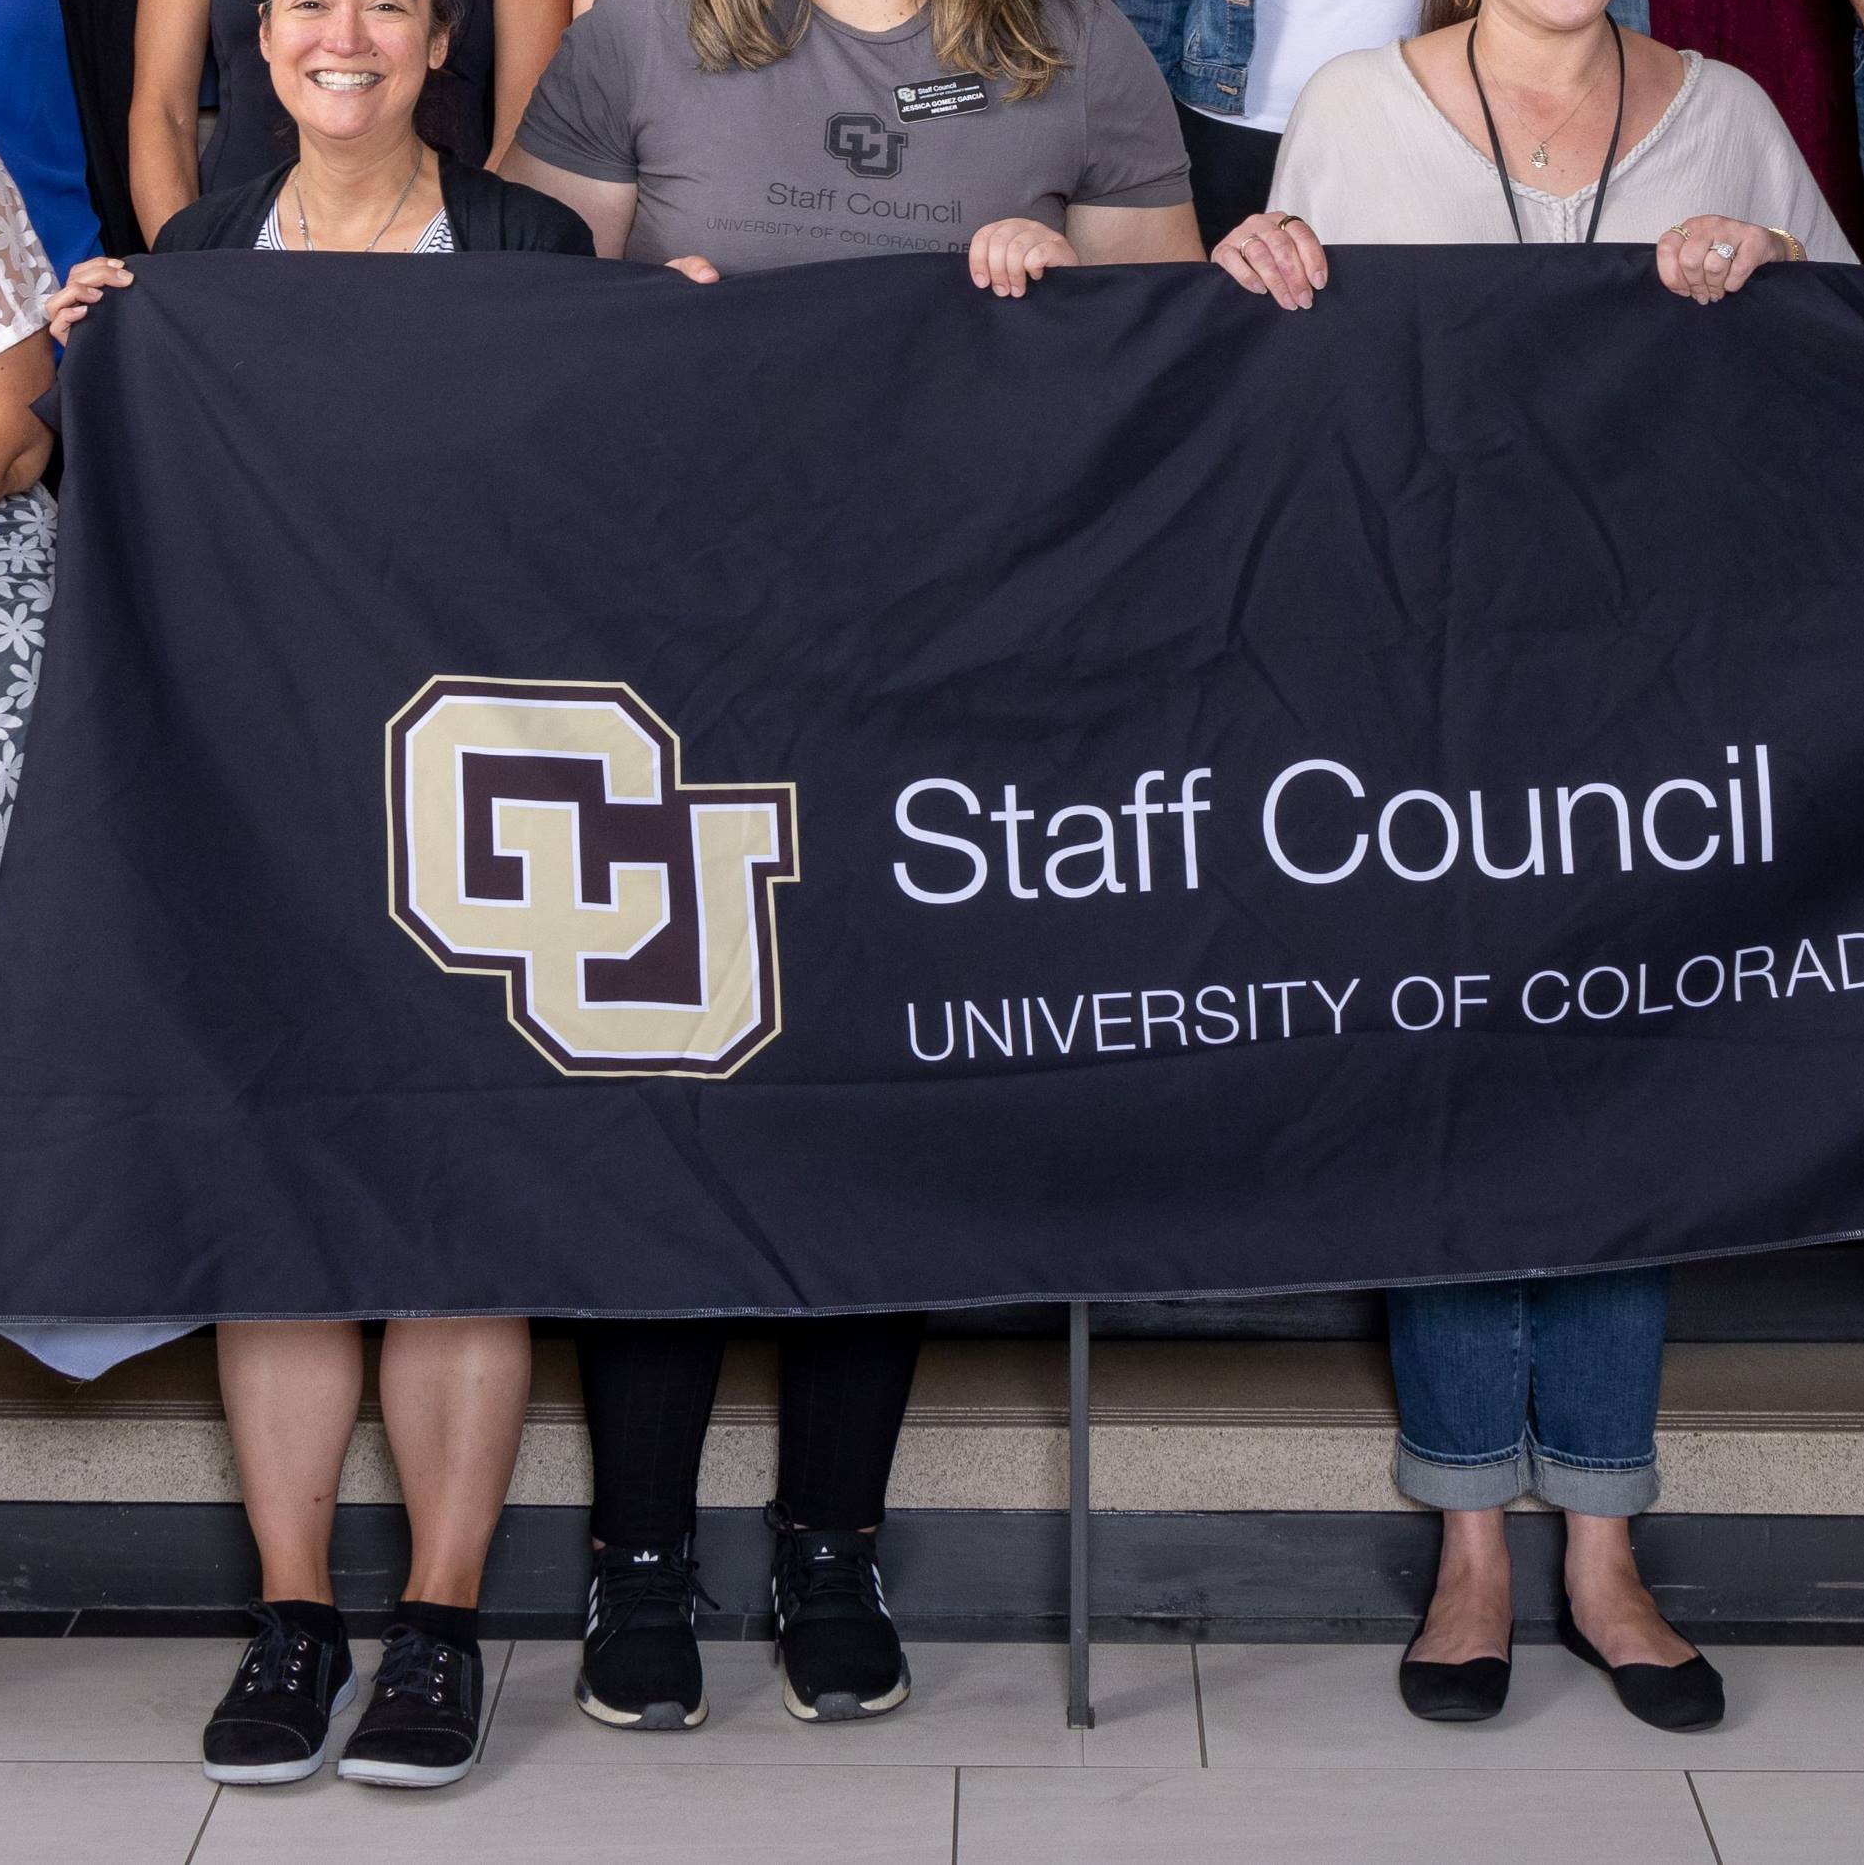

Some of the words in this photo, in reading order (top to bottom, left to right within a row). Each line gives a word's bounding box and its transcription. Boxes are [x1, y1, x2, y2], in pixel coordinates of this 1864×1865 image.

[897, 87, 916, 102] CU
[901, 102, 931, 113] JESSICA
[931, 97, 957, 107] GOMEZ
[957, 92, 985, 103] GARCIA
[917, 86, 933, 95] Staff
[933, 82, 957, 92] Council
[931, 104, 958, 114] MEMBER
[824, 112, 908, 179] CU
[766, 182, 838, 212] Staff
[847, 192, 963, 225] Council
[706, 217, 804, 237] UNIVERSITY
[810, 226, 833, 239] OF
[840, 230, 941, 253] COLORADO
[892, 766, 1212, 905] Staff
[1262, 744, 1774, 885] Council
[385, 675, 800, 1079] CU
[906, 976, 1361, 1063] UNIVERSITY
[1390, 974, 1492, 1032] OF
